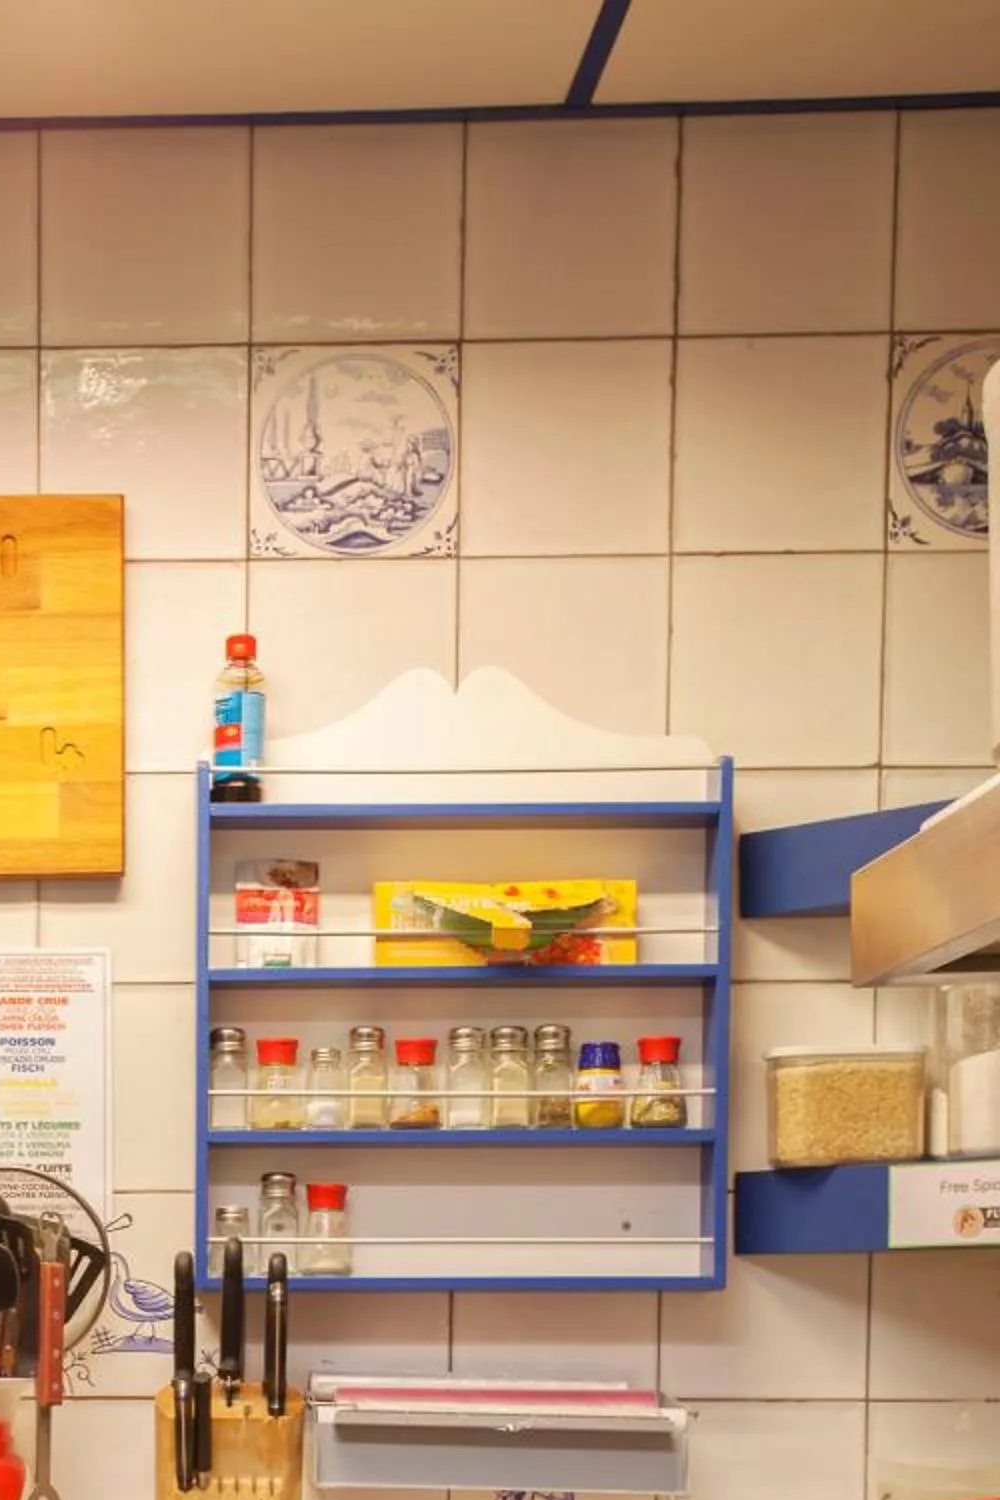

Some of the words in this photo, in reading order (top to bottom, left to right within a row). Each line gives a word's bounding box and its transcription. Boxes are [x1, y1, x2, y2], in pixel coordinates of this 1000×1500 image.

[37, 996, 70, 1006] CRUE
[0, 1037, 56, 1047] POISSON
[11, 1063, 45, 1073] FISCH
[939, 1180, 969, 1194] Free
